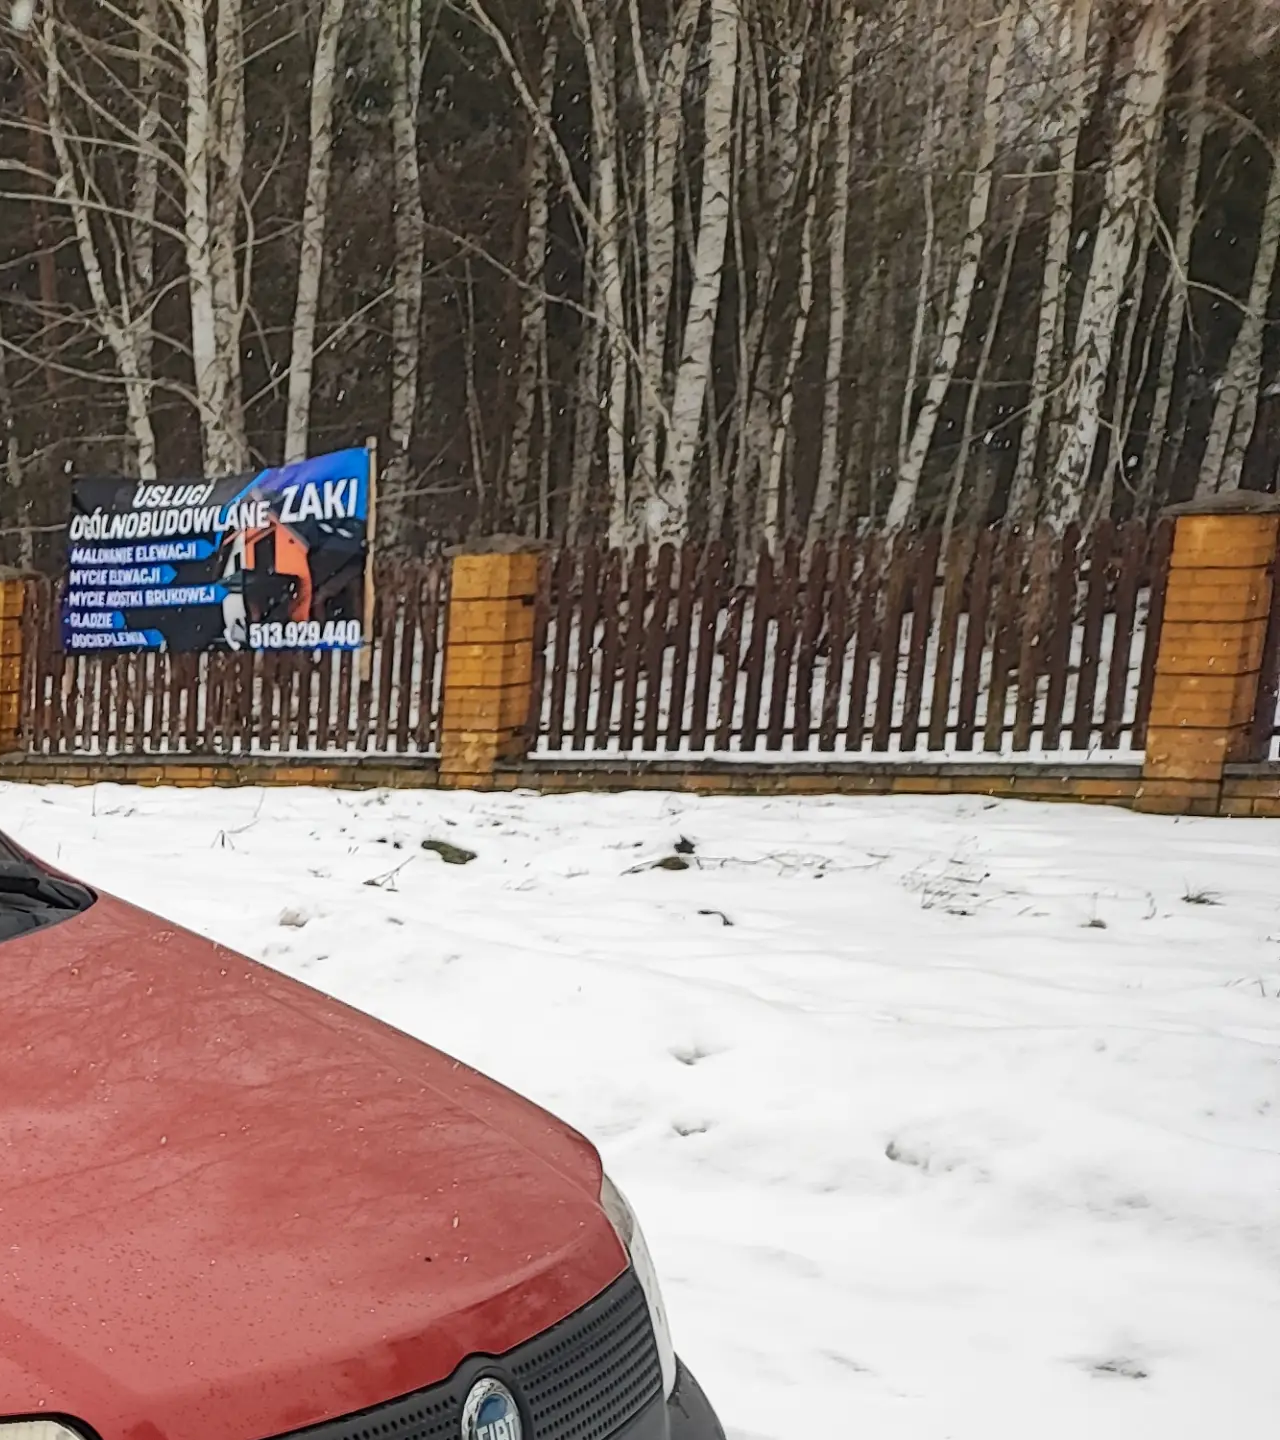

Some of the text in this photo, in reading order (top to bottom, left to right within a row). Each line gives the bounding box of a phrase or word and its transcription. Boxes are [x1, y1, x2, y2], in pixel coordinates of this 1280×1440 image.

[279, 478, 359, 524] ZAKI
[135, 543, 197, 562] ELEWACJI
[69, 569, 107, 586] MYCIE
[69, 586, 215, 607] MYCIE KOSTKI BRUKOWEJ
